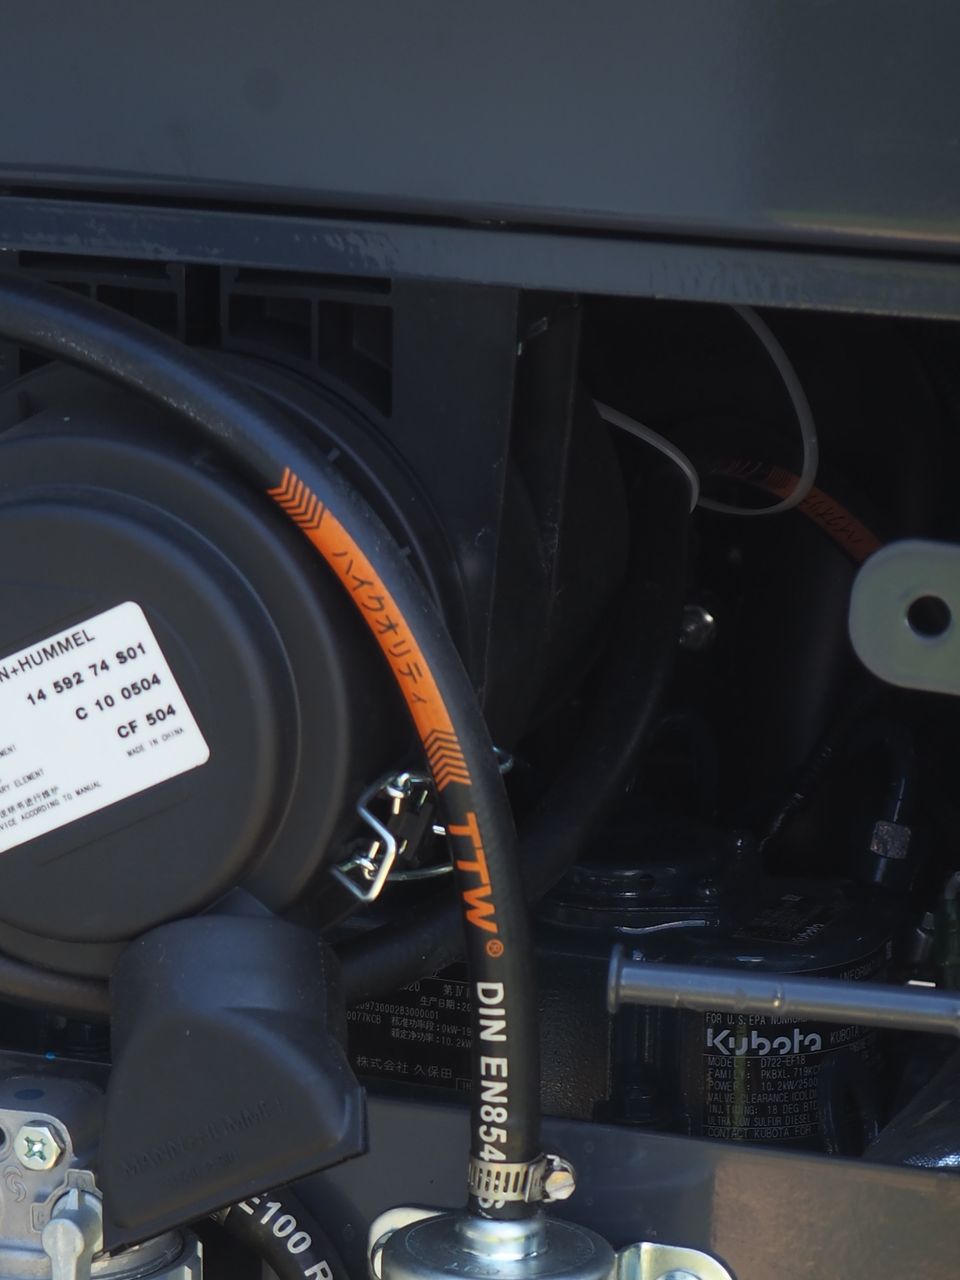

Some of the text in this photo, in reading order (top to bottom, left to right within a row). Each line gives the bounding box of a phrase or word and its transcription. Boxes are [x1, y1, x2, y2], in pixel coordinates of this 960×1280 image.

[332, 551, 428, 705] ハイクオリティ
[26, 641, 147, 706] 14 592 74 S01
[75, 672, 162, 721] C 10 0504
[117, 703, 177, 740] CF 504
[127, 743, 147, 758] MADE
[161, 727, 185, 743] CHINA
[14, 767, 46, 788] ELEMENT
[21, 797, 60, 823] ACCORDING
[62, 791, 74, 804] TO
[75, 779, 103, 798] MANUAL
[476, 981, 508, 1042] DIN
[706, 1012, 722, 1024] FOR
[706, 1027, 823, 1056] Kubota
[479, 1056, 509, 1163] EN854
[753, 1116, 782, 1127] SULFUR
[785, 1113, 811, 1126] DIESEL
[782, 1103, 799, 1114] DEG
[754, 1127, 790, 1138] KUBOTA
